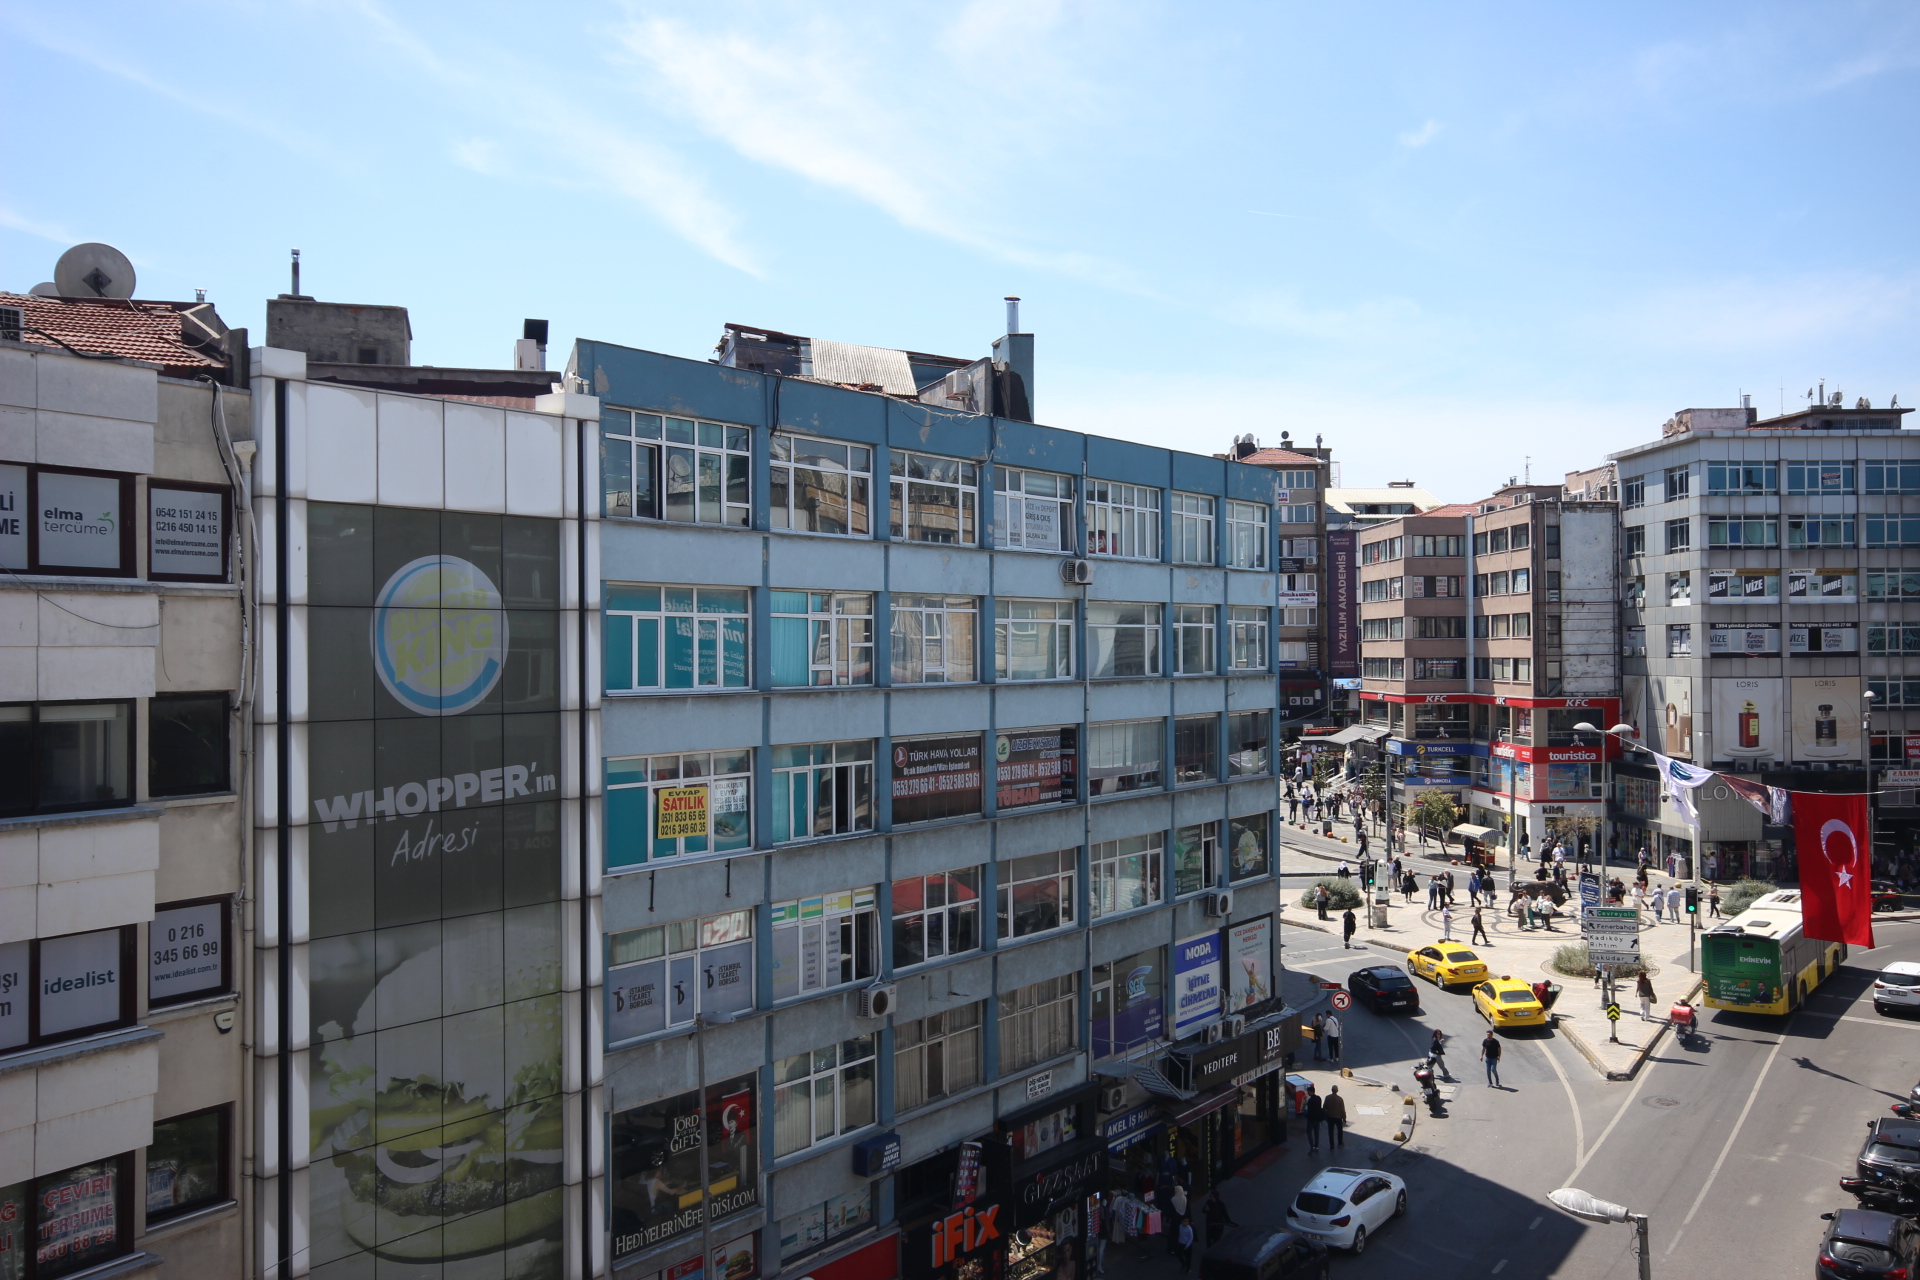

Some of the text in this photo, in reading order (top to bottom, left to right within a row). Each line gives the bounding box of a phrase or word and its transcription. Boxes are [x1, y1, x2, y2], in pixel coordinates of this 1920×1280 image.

[44, 507, 83, 521] elma
[156, 508, 217, 520] 0542 151 24 15
[44, 521, 107, 535] tercüme
[156, 522, 217, 534] 0216 450 14 15
[1336, 552, 1347, 609] AKADEMİSİ
[1709, 580, 1726, 594] BİLET
[1745, 579, 1763, 594] VİZE
[1789, 578, 1805, 593] HAC
[1823, 579, 1841, 593] UMRE
[391, 588, 489, 642] BURGER
[395, 602, 494, 683] KING
[1339, 612, 1348, 654] YAZILIM
[1496, 697, 1505, 705] KFC
[1565, 699, 1589, 707] KFC
[909, 747, 977, 762] TÜRK HAVA YOLLARI
[1493, 745, 1515, 758] touristica
[1549, 751, 1597, 761] touristica
[997, 766, 1010, 781] 0553
[1012, 764, 1021, 779] 279
[1022, 764, 1028, 778] 66
[1029, 764, 1034, 777] 41
[1038, 762, 1050, 776] 0552
[1062, 759, 1072, 772] 61
[893, 772, 980, 796] 0553 279 66 41 0552 589 53 61
[663, 796, 704, 812] SATILIK
[997, 785, 1039, 806] TÜRSAB
[662, 810, 705, 823] 0531 833 65 65
[661, 822, 705, 835] 0216 349 60 35
[391, 819, 479, 867] Adresi
[168, 923, 204, 942] 0 216
[1590, 935, 1623, 943] Kadıköy
[154, 941, 218, 966] 345 66 99
[1185, 942, 1211, 961] MODA
[1739, 956, 1771, 964] EMİNEVİM
[44, 969, 115, 995] idealist
[154, 963, 218, 982] www.idealist.com.tr
[719, 976, 739, 986] BORSASI
[0, 972, 18, 993] şı
[1129, 976, 1146, 995] SGK
[1187, 973, 1210, 992] İŞİTME
[629, 999, 653, 1009] BORSASI
[1267, 1027, 1280, 1050] BE
[674, 1115, 699, 1137] LORD
[1107, 1114, 1137, 1138] AKEL İŞ
[670, 1130, 702, 1152] GIFTS
[883, 1152, 899, 1164] AVUKAT
[43, 1171, 112, 1213] ÇEVİRİ
[39, 1202, 113, 1239] TERCÜME
[616, 1188, 754, 1255] HEDİYELERİNEFEDİSİ.COM
[932, 1203, 1000, 1269] iFix
[36, 1240, 67, 1264] 550
[72, 1234, 92, 1252] 88
